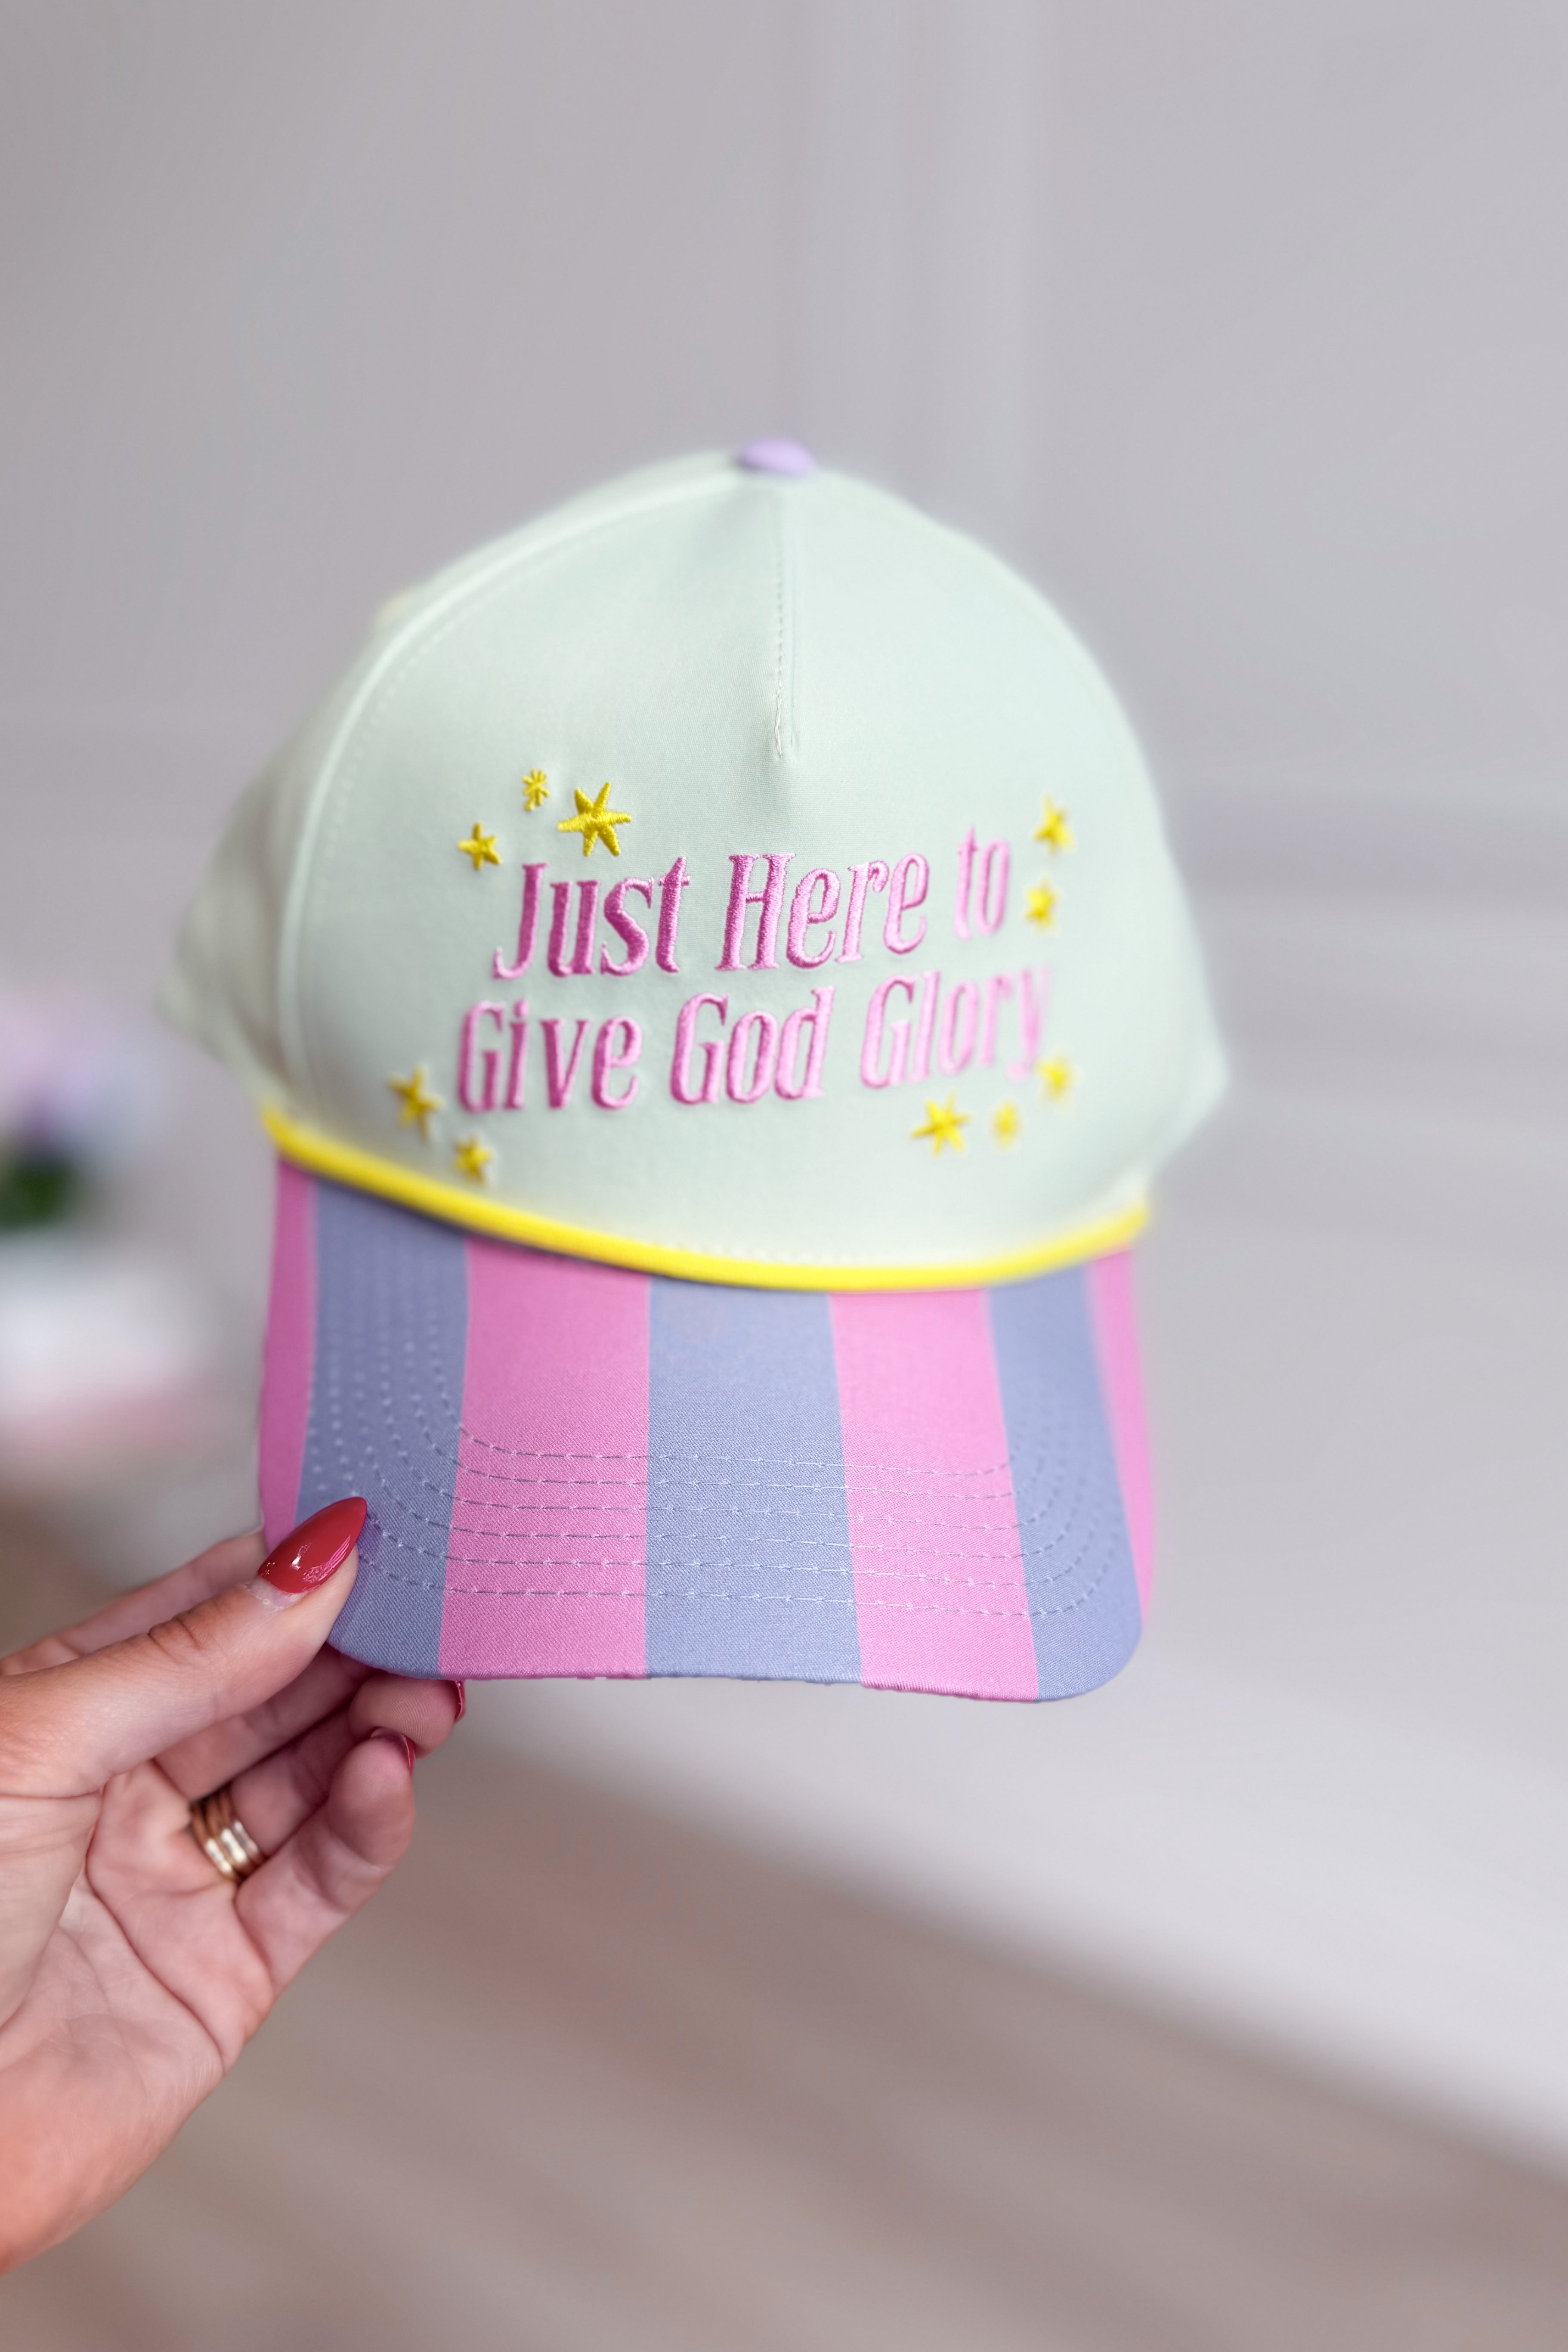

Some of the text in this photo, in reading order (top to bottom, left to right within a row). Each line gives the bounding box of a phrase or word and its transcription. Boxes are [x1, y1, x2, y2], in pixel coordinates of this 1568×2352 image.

[492, 826, 1011, 981] Just Here to
[456, 964, 1051, 1114] Give God Glory
